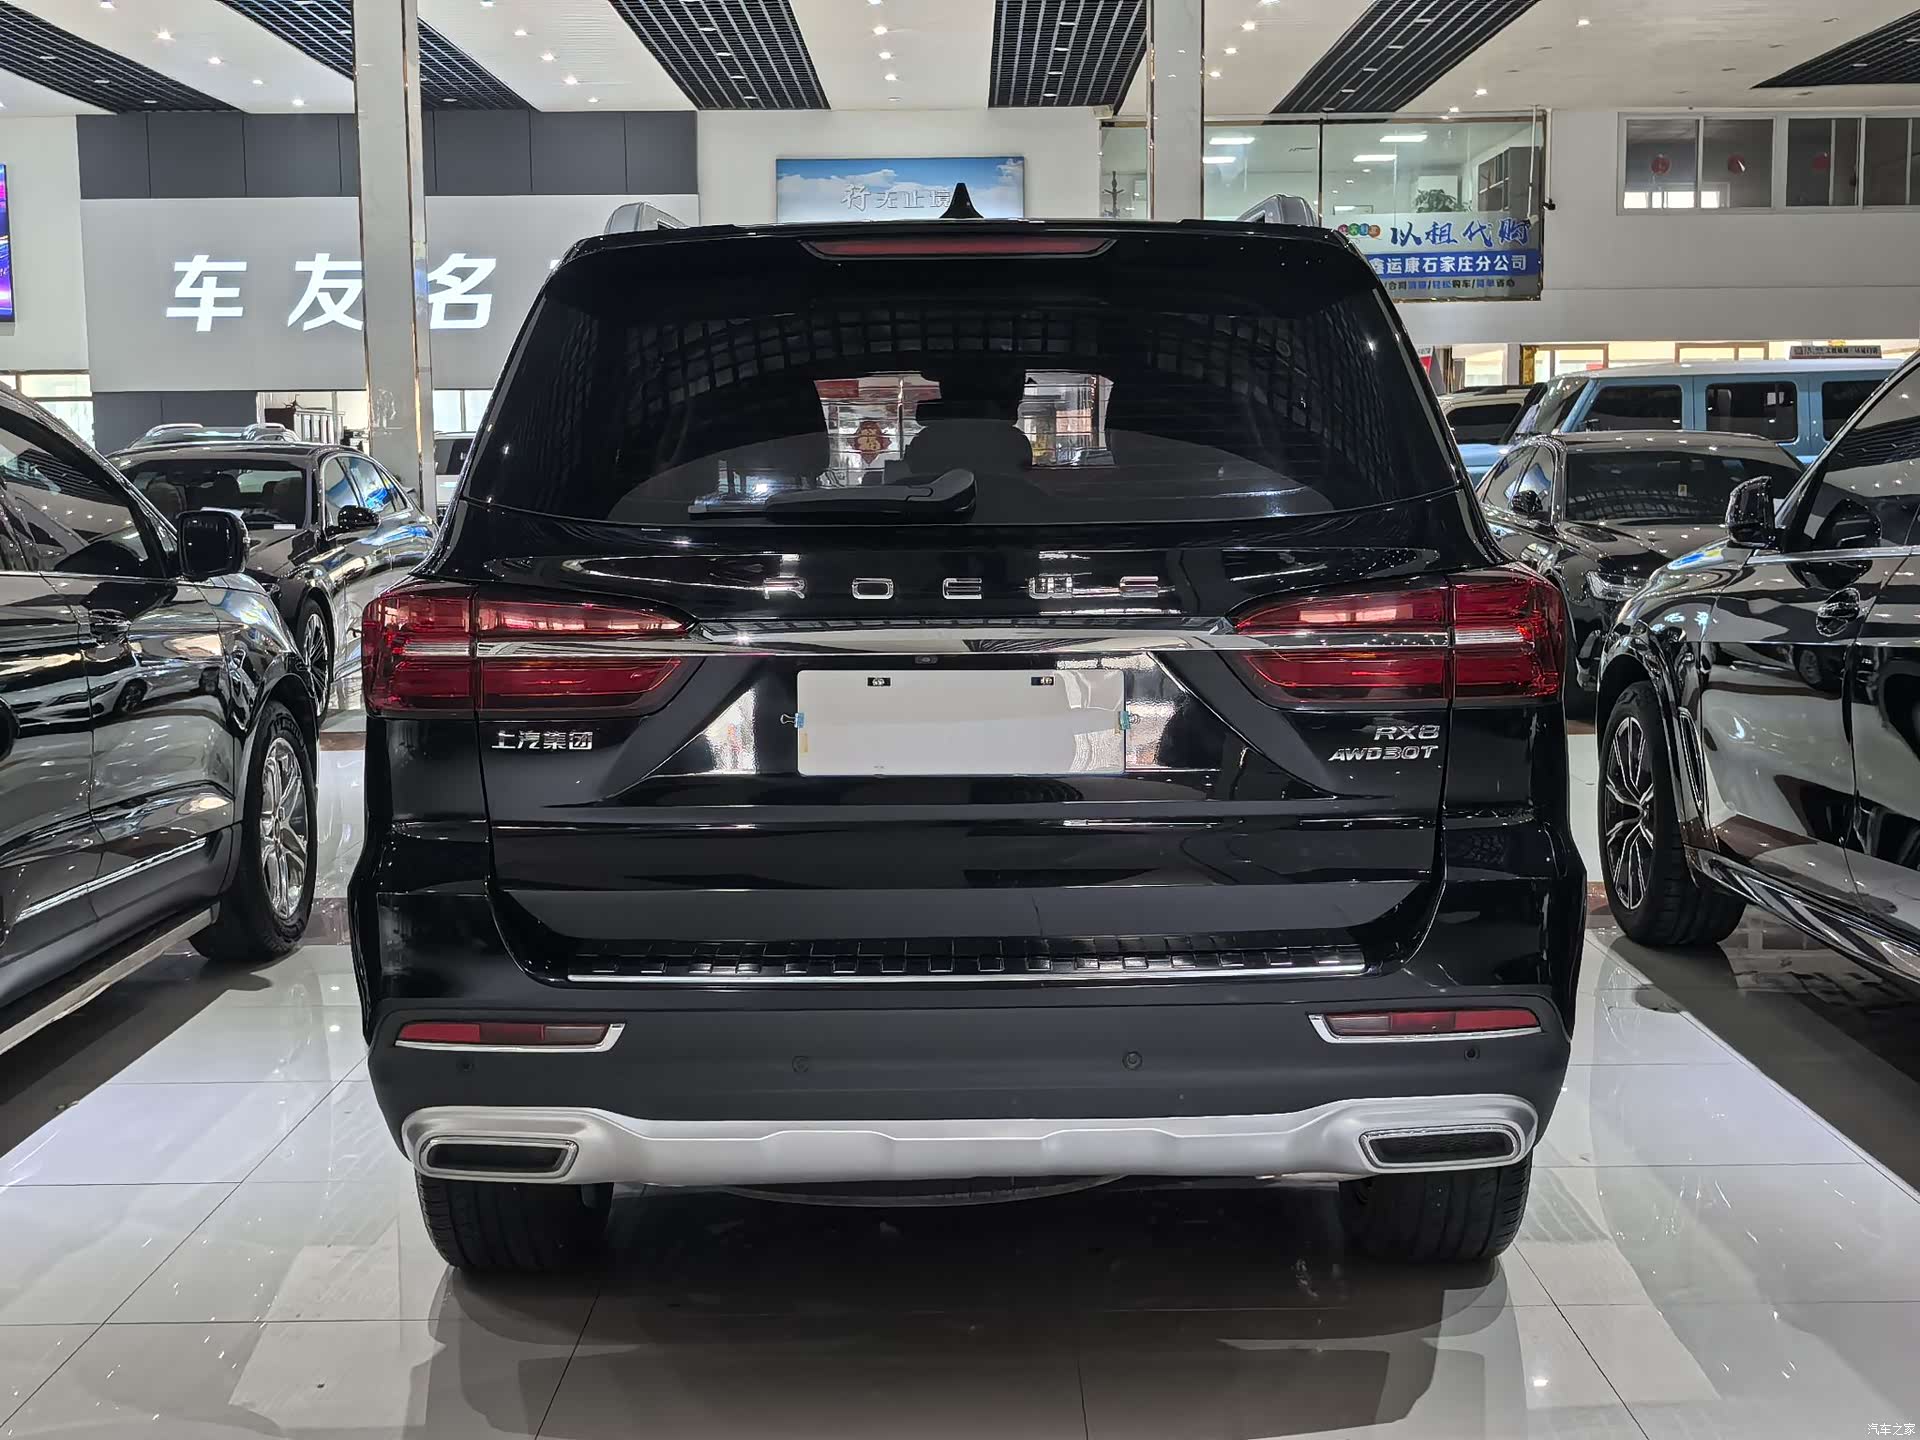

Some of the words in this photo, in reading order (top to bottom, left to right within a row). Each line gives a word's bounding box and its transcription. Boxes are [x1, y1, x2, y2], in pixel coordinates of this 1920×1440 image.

[1390, 217, 1529, 247] 以租代购
[166, 252, 556, 333] 车友名
[762, 575, 1160, 600] ROEWE
[491, 730, 593, 750] 上汽集团
[1373, 725, 1440, 741] RX8
[1328, 745, 1439, 761] AWD30T
